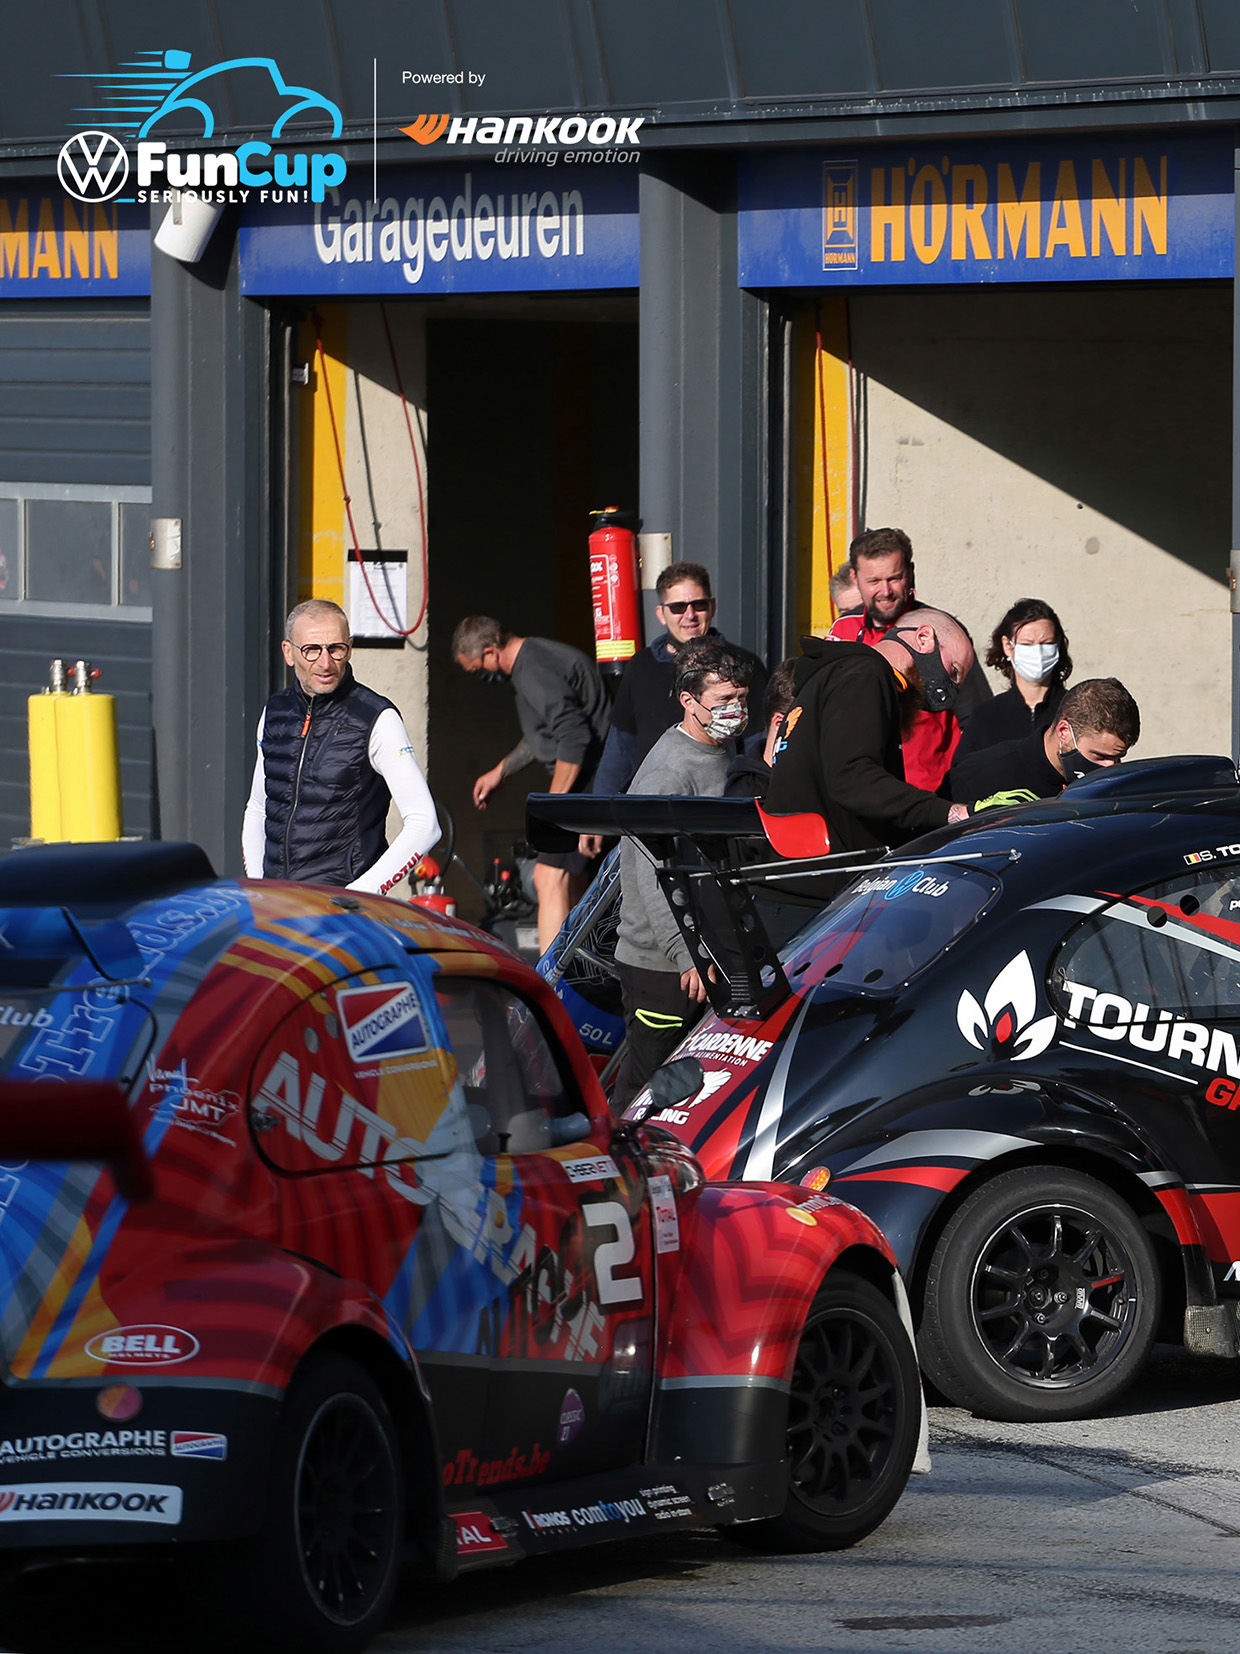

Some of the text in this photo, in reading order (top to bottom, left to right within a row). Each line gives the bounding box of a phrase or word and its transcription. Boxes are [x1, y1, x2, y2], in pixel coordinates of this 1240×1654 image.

[870, 155, 1168, 264] HÖRMANN
[313, 172, 585, 284] Garagedeuren
[1200, 850, 1217, 862] S.
[380, 851, 424, 894] MOTUL
[851, 876, 898, 896] Belgian
[911, 877, 949, 897] Club
[0, 1005, 54, 1027] lub
[351, 992, 417, 1050] AUTOGRAPHE
[169, 1098, 226, 1120] JMT
[582, 1201, 643, 1305] 2
[101, 1334, 181, 1354] BELL
[0, 1430, 167, 1457] AUTOGRAPHE
[0, 1447, 167, 1465] VEHICLE CONVERSIONS
[571, 1499, 647, 1526] comtoyou
